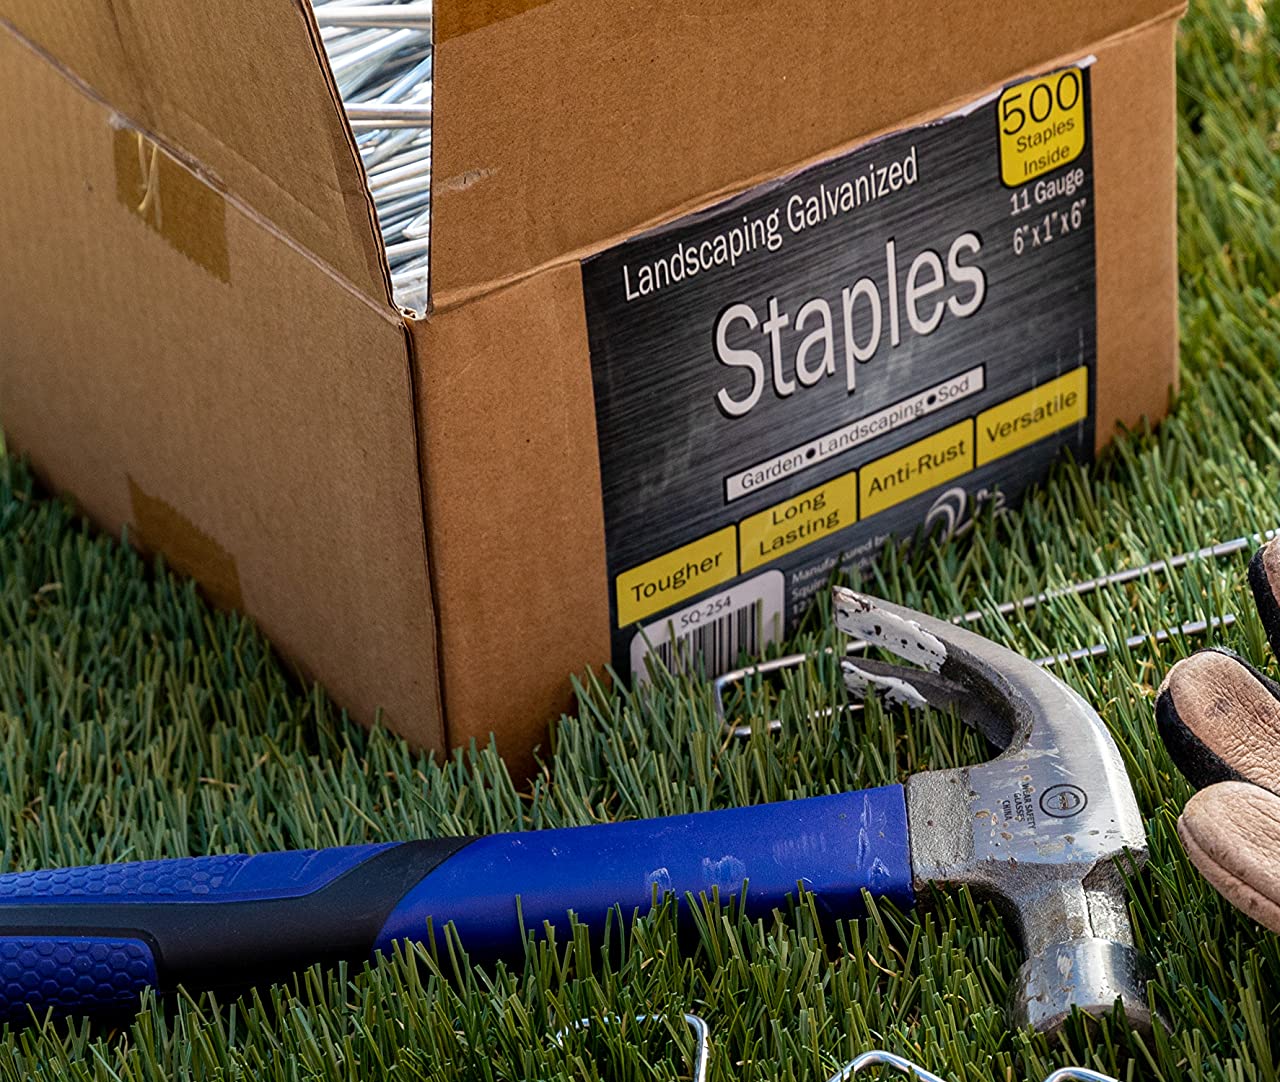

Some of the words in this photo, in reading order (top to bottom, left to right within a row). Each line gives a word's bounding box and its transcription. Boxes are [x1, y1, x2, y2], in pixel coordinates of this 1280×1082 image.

[1003, 71, 1079, 135] 500
[1016, 117, 1075, 153] Staples
[1023, 145, 1071, 176] Inside
[1010, 188, 1031, 216] 11
[1034, 167, 1085, 204] Gauge
[623, 207, 783, 301] Landscaping
[786, 145, 918, 233] Galvanized
[716, 230, 985, 417] Staples
[741, 453, 803, 489] Garden
[937, 376, 969, 402] Sod
[986, 391, 1077, 442] Versatile
[868, 440, 967, 497] Anti-Rust
[772, 491, 827, 526] Long
[759, 509, 841, 557] Lasting
[631, 552, 723, 602] Tougher
[681, 596, 732, 629] SQ-254
[1002, 800, 1012, 821] CHINA
[1014, 792, 1026, 822] GLASSES
[1025, 804, 1036, 829] SAFETY
